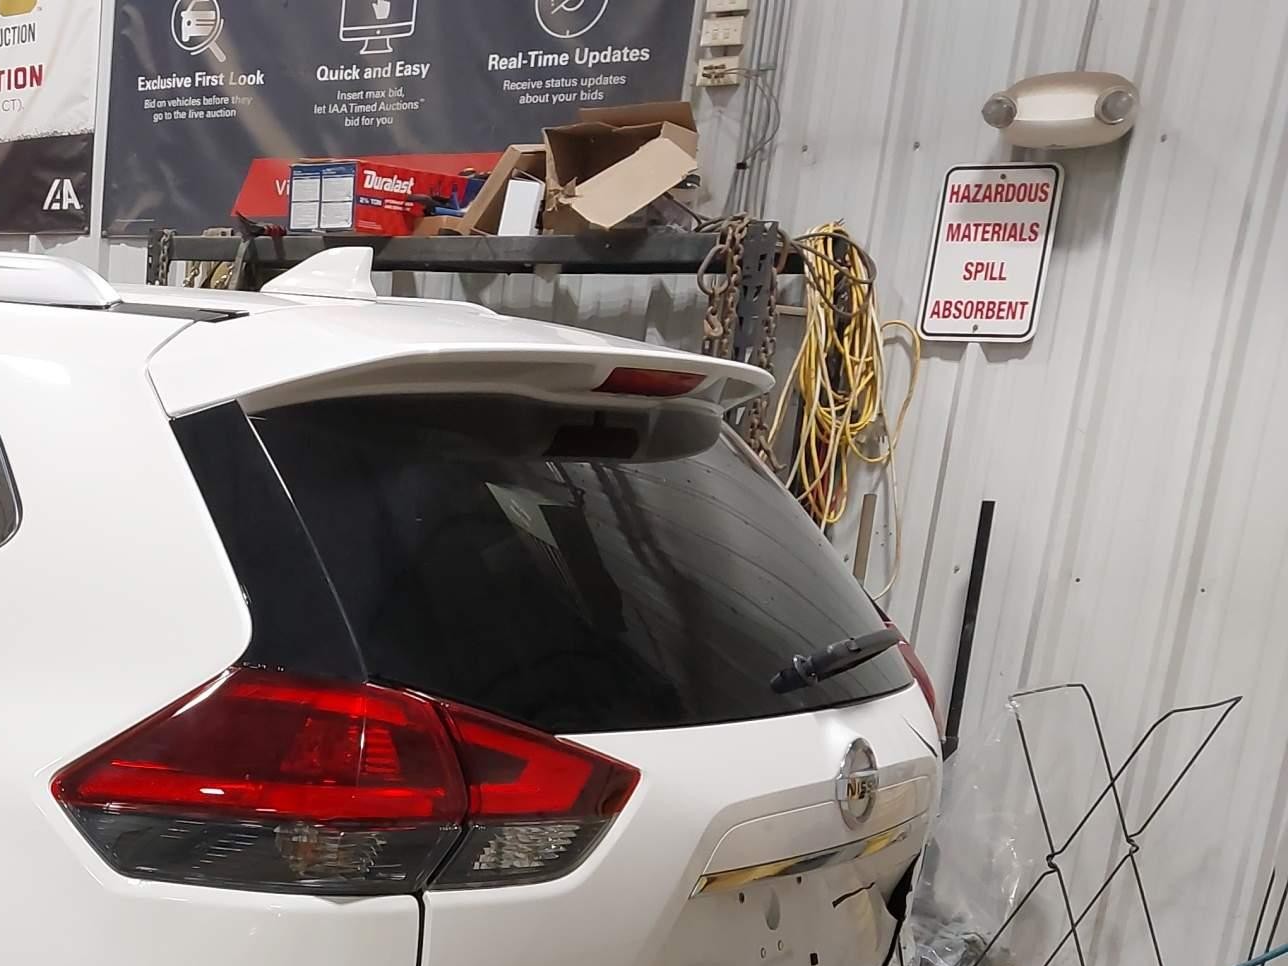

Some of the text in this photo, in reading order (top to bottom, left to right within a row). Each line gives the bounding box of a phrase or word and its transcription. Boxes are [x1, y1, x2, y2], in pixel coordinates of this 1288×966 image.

[488, 46, 650, 71] Real-Time Updates
[138, 70, 264, 91] Exclusive First Look
[316, 61, 430, 81] Quick and Easy
[503, 74, 626, 91] Receive status updates
[144, 98, 155, 109] Bid
[157, 100, 167, 108] on
[168, 96, 201, 107] vehicles
[203, 95, 229, 106] before
[337, 87, 405, 100] Insert max bid,
[519, 89, 604, 104] about your bids
[153, 108, 237, 122] go to the live auction
[314, 104, 326, 114] let
[328, 103, 348, 114] IAA
[349, 102, 377, 112] Timed
[344, 115, 394, 127] bid for you
[363, 169, 414, 195] Duralast
[949, 183, 1050, 203] HAZARDOUS
[946, 222, 1040, 242] MATERIALS
[963, 261, 1007, 281] SPILL
[930, 300, 1029, 320] ABSORBENT
